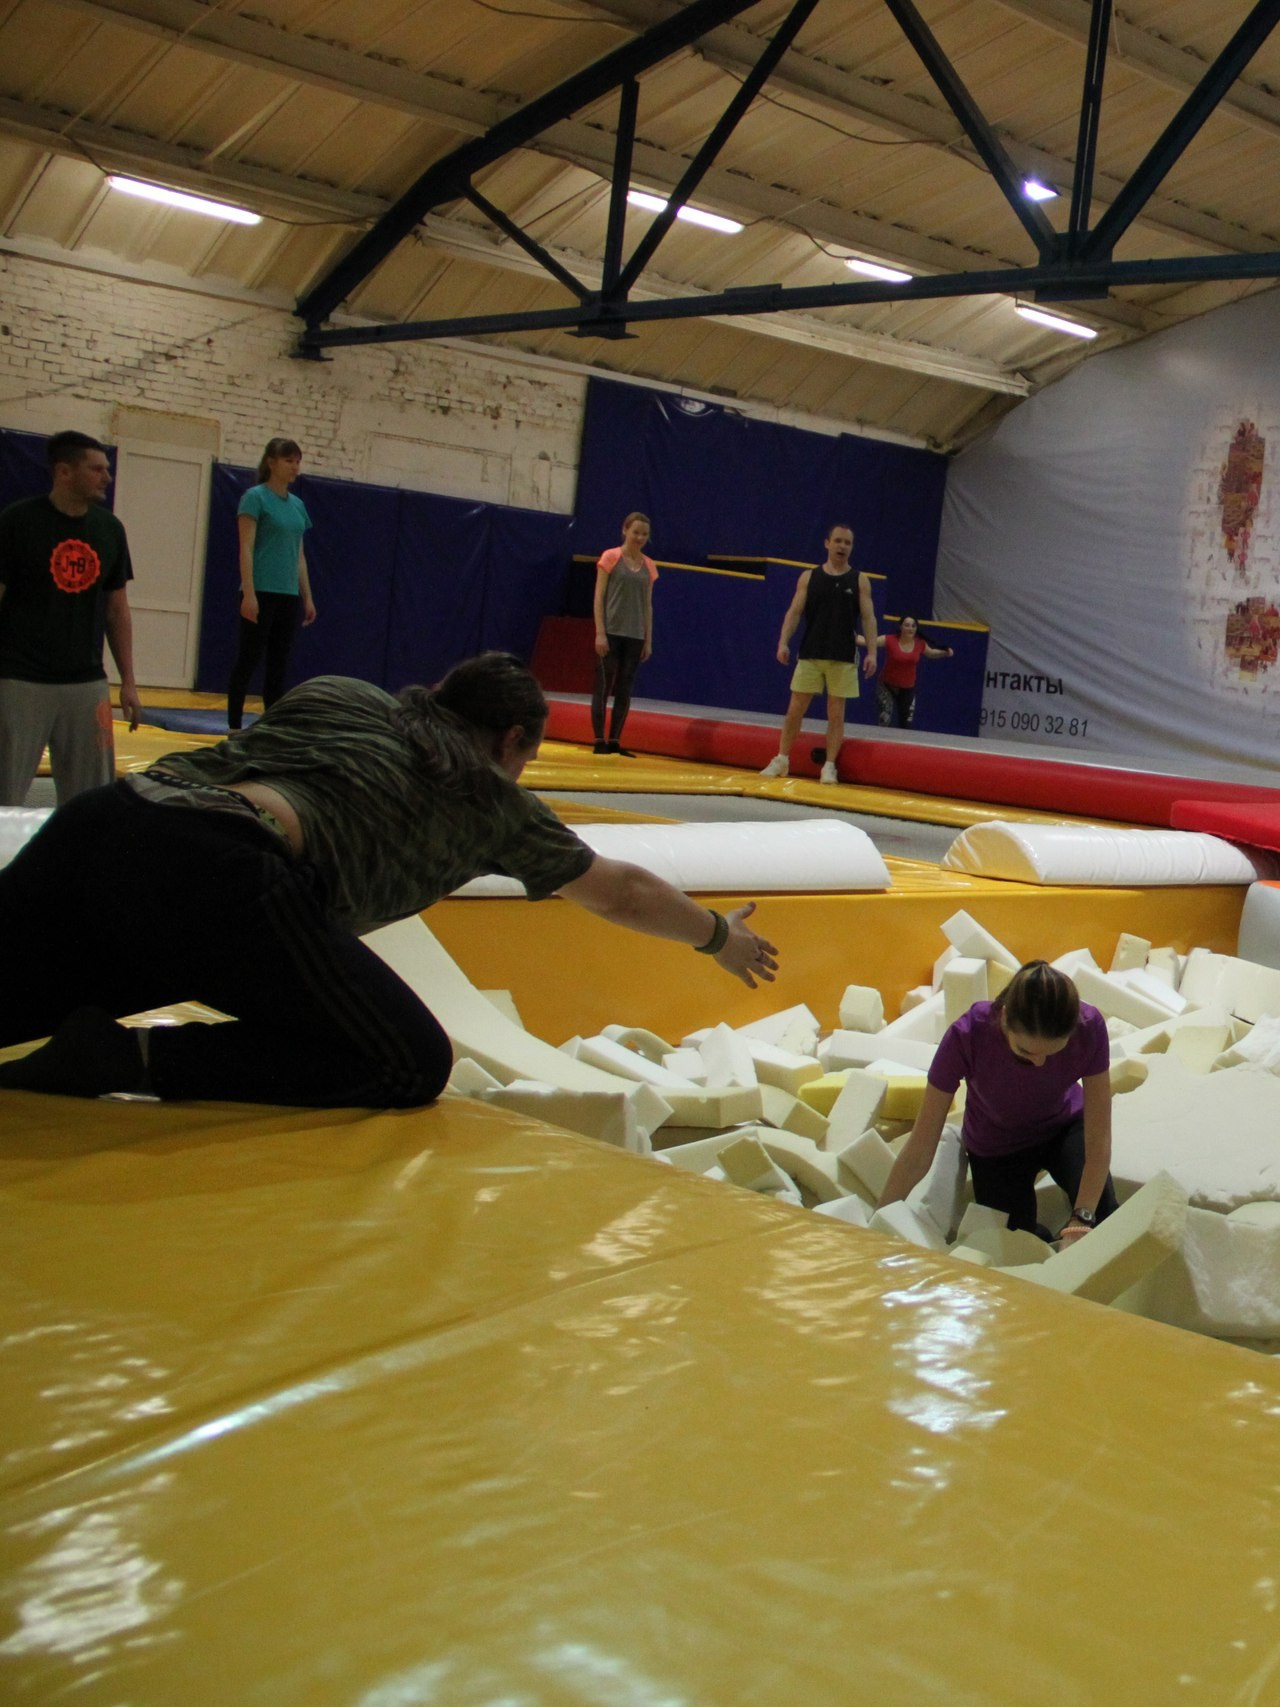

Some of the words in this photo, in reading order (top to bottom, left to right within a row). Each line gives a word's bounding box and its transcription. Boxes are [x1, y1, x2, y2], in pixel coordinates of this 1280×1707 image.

[1011, 711, 1040, 731] 090
[1044, 715, 1064, 734] 32
[1068, 717, 1089, 737] 81
